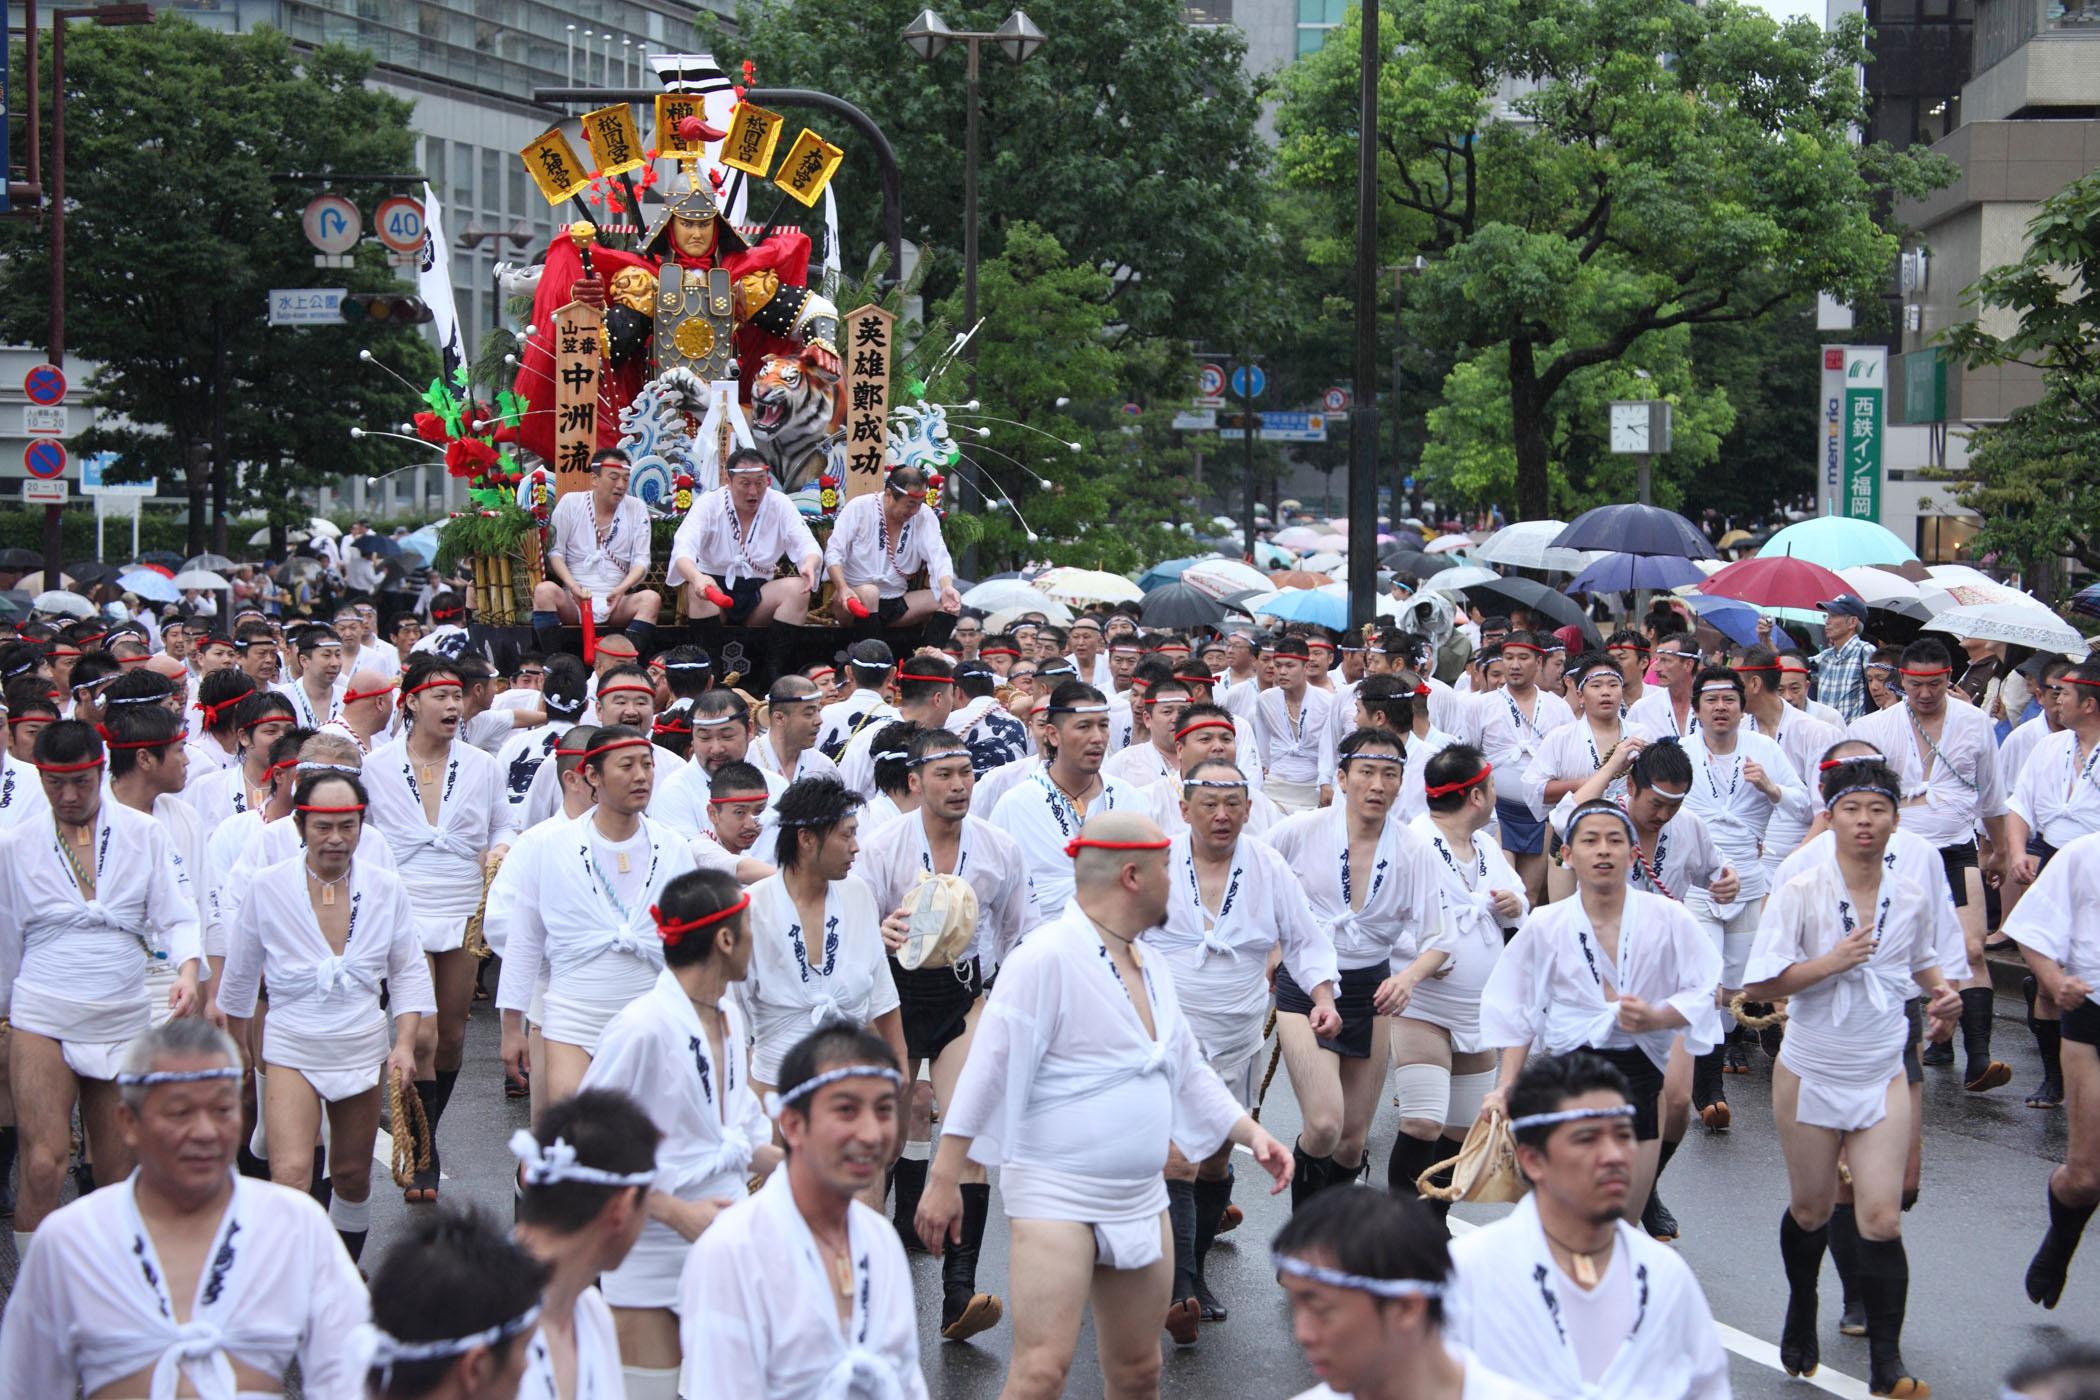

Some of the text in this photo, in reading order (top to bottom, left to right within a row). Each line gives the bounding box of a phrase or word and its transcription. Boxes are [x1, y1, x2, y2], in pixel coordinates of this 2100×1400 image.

[389, 212, 419, 236] 40
[279, 295, 339, 310] 水上公園
[559, 362, 595, 473] 中洲流
[850, 316, 887, 475] 英雄鄭成功
[1825, 398, 1839, 485] memoria
[1851, 397, 1875, 517] 西鉄イン福岡
